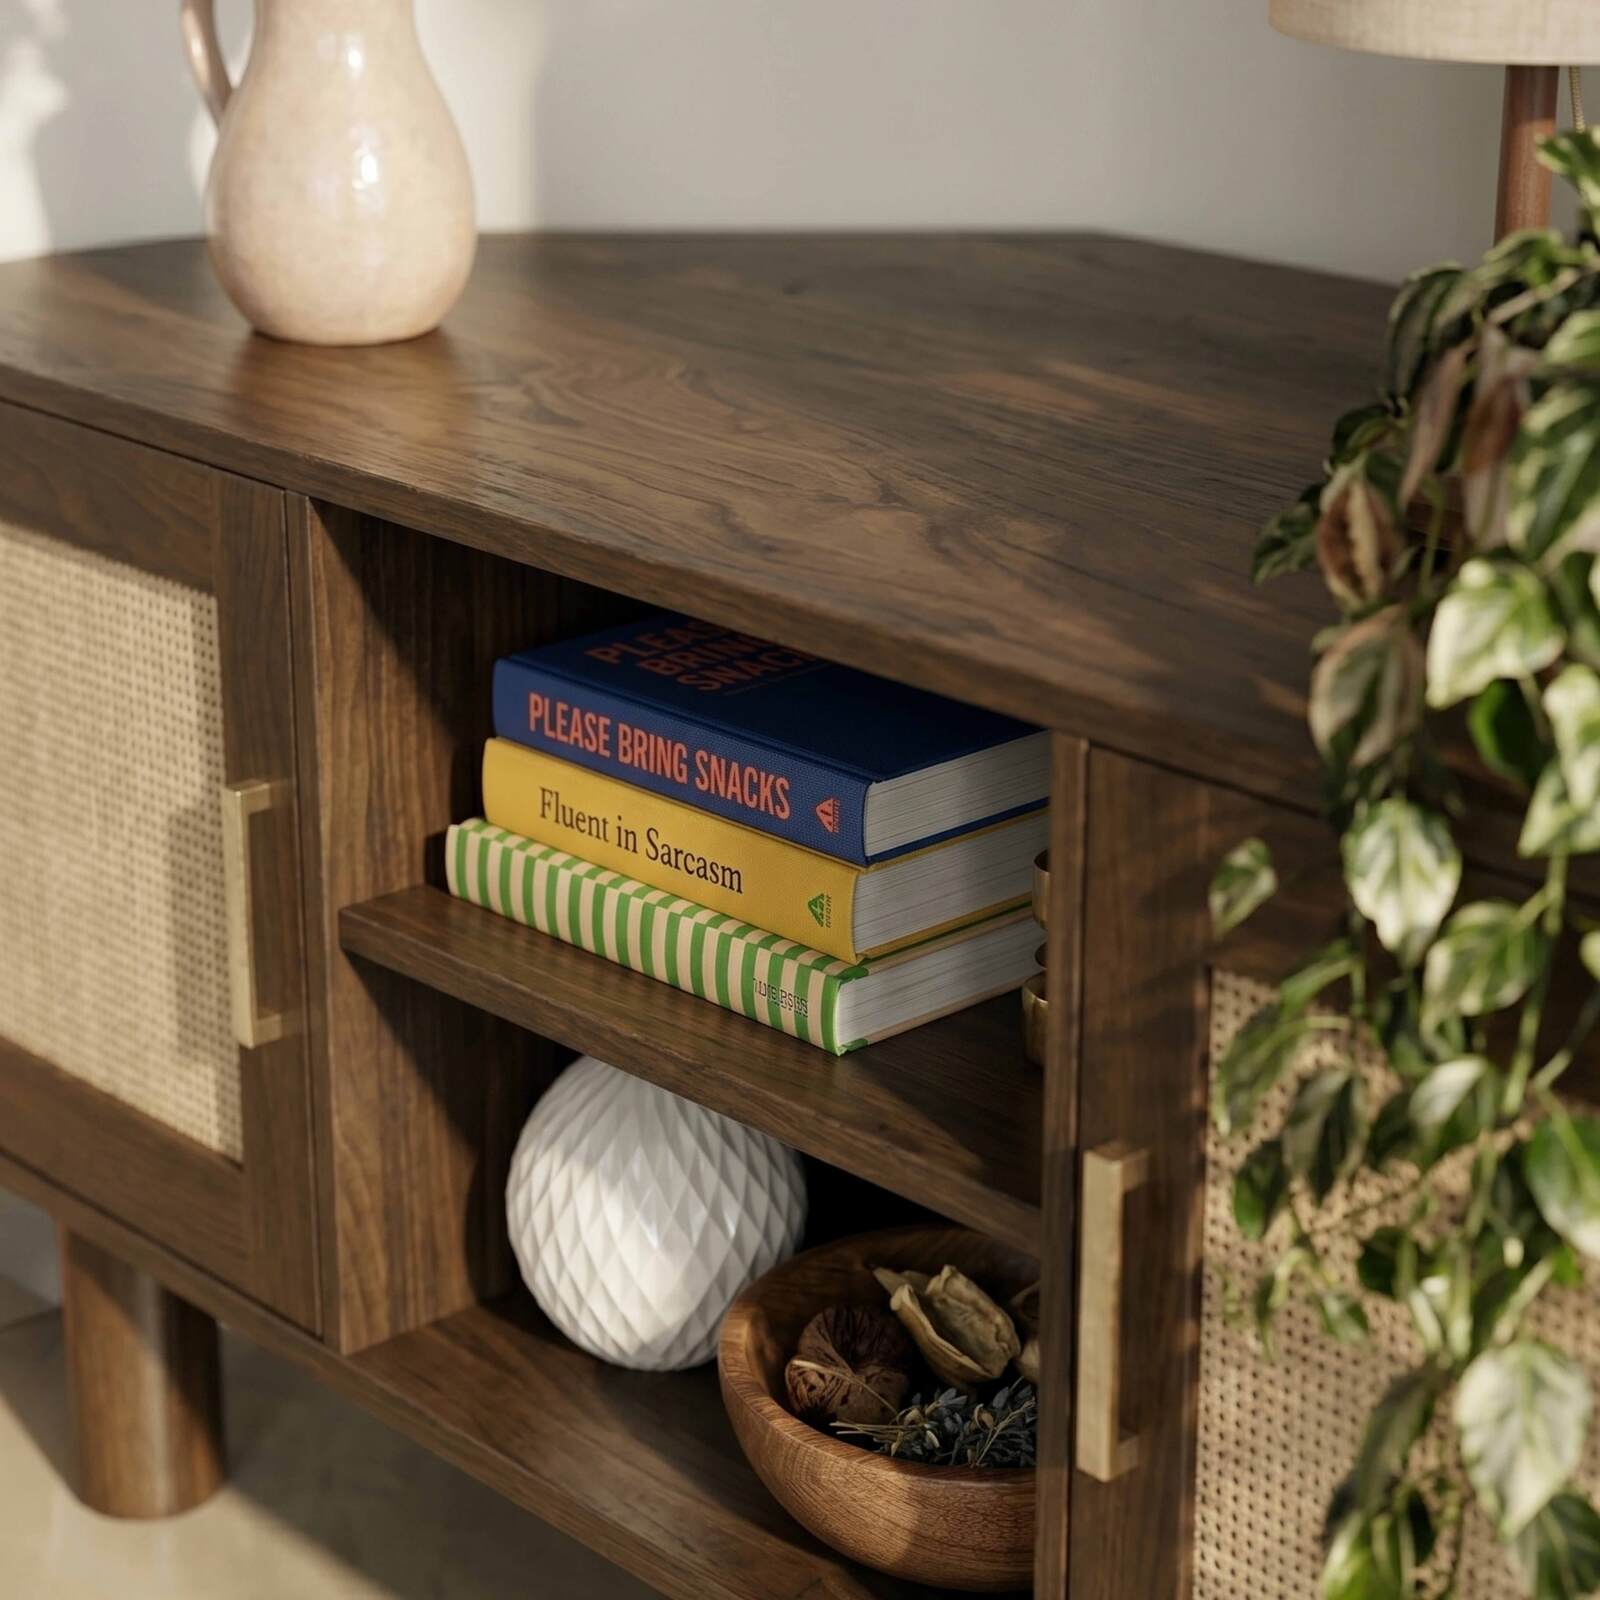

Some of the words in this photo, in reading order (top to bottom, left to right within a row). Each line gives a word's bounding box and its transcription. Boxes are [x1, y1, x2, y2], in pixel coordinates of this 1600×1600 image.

[636, 634, 774, 676] BRIN
[529, 692, 611, 757] PLEASE
[618, 723, 688, 785] BRING
[695, 749, 791, 820] SNACKS
[539, 786, 609, 843] Fluent
[616, 815, 638, 854] in
[645, 827, 743, 895] Sarcasm
